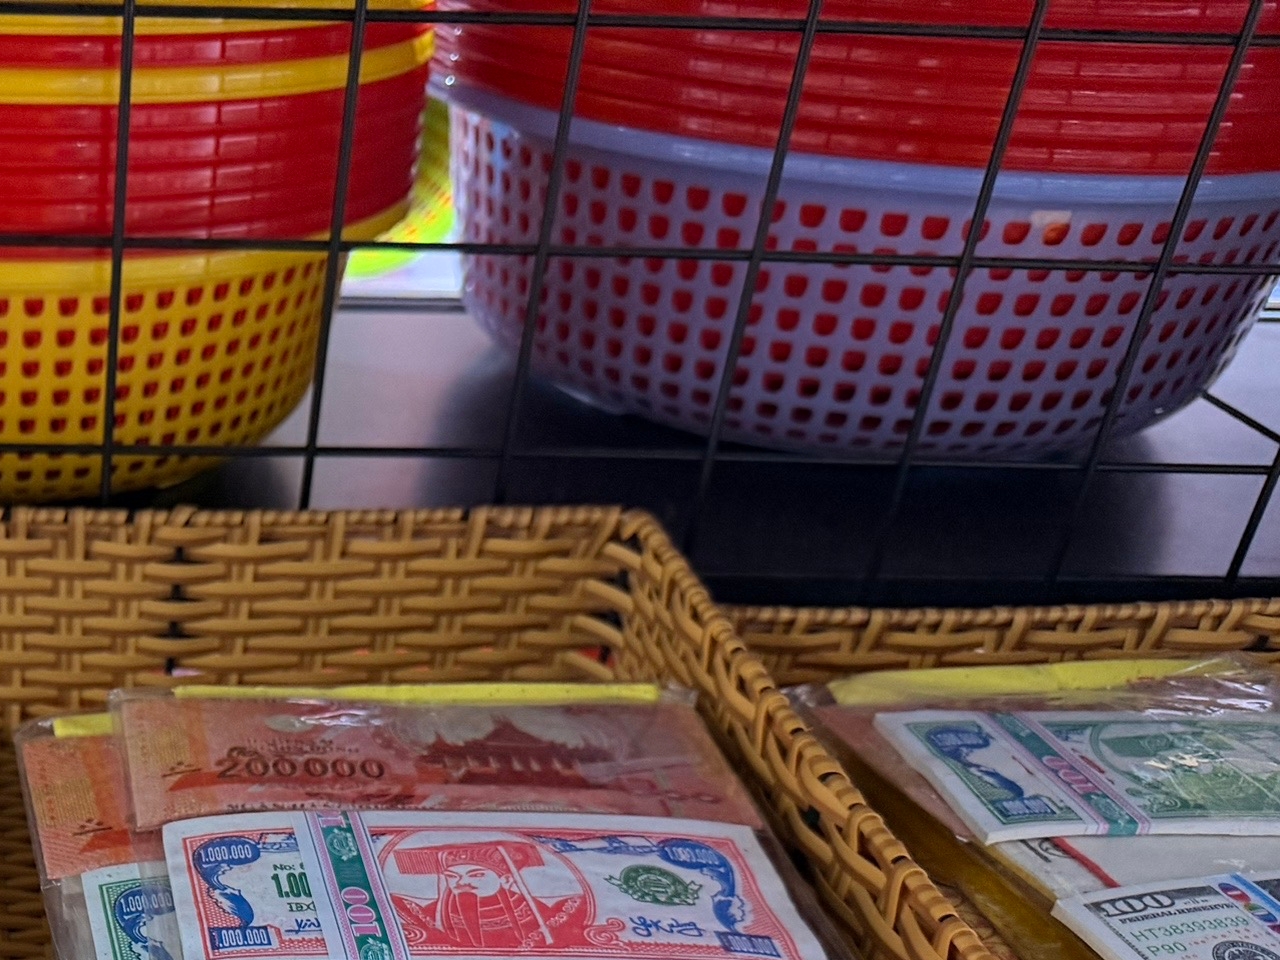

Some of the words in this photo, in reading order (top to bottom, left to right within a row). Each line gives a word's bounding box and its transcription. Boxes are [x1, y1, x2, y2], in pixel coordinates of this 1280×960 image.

[215, 757, 385, 779] 200000
[200, 844, 253, 863] 1.000.000
[341, 886, 382, 938] 100
[1098, 892, 1176, 917] 100
[1147, 942, 1188, 957] P90
